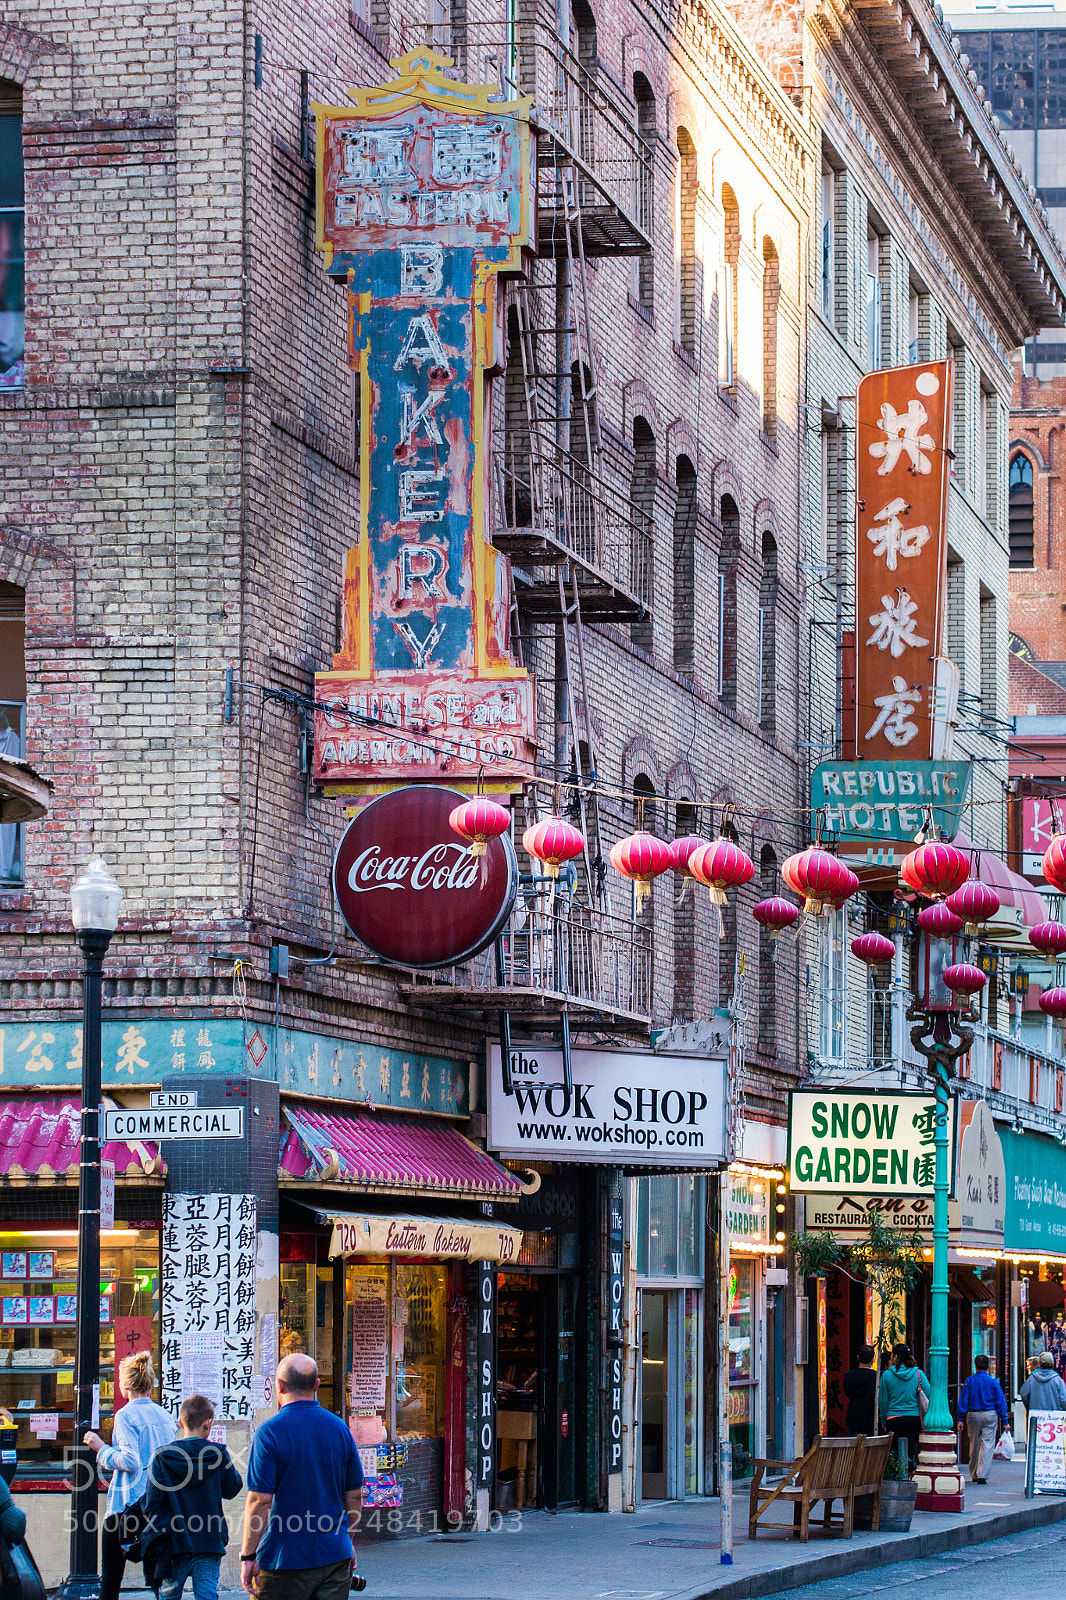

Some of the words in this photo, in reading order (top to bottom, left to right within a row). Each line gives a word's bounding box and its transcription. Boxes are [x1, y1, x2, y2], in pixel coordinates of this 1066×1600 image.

[335, 190, 510, 227] EASTERN
[391, 242, 452, 673] BAKERY
[324, 692, 466, 729] CHINESE
[472, 690, 521, 726] and
[320, 739, 441, 766] AMERICAN
[449, 736, 517, 764] FOOD
[821, 770, 960, 796] REPUBLIC
[823, 801, 943, 833] HOTEL
[348, 843, 479, 893] Coca-Cola
[511, 1052, 539, 1075] the
[157, 1094, 190, 1106] END
[511, 1080, 596, 1119] WOK
[613, 1086, 708, 1126] SHOP
[114, 1114, 232, 1134] COMMERCIAL
[517, 1122, 705, 1149] www.wokshop.com
[811, 1101, 899, 1141] SNOW
[795, 1145, 909, 1185] GARDEN
[814, 1212, 881, 1225] RESTAURA
[336, 1223, 357, 1251] 720
[385, 1221, 428, 1252] Eastern
[432, 1224, 472, 1258] Bakery
[498, 1234, 514, 1260] 720
[611, 1252, 623, 1330] WOK
[481, 1359, 492, 1481] SHOP
[611, 1358, 622, 1466] SHOP
